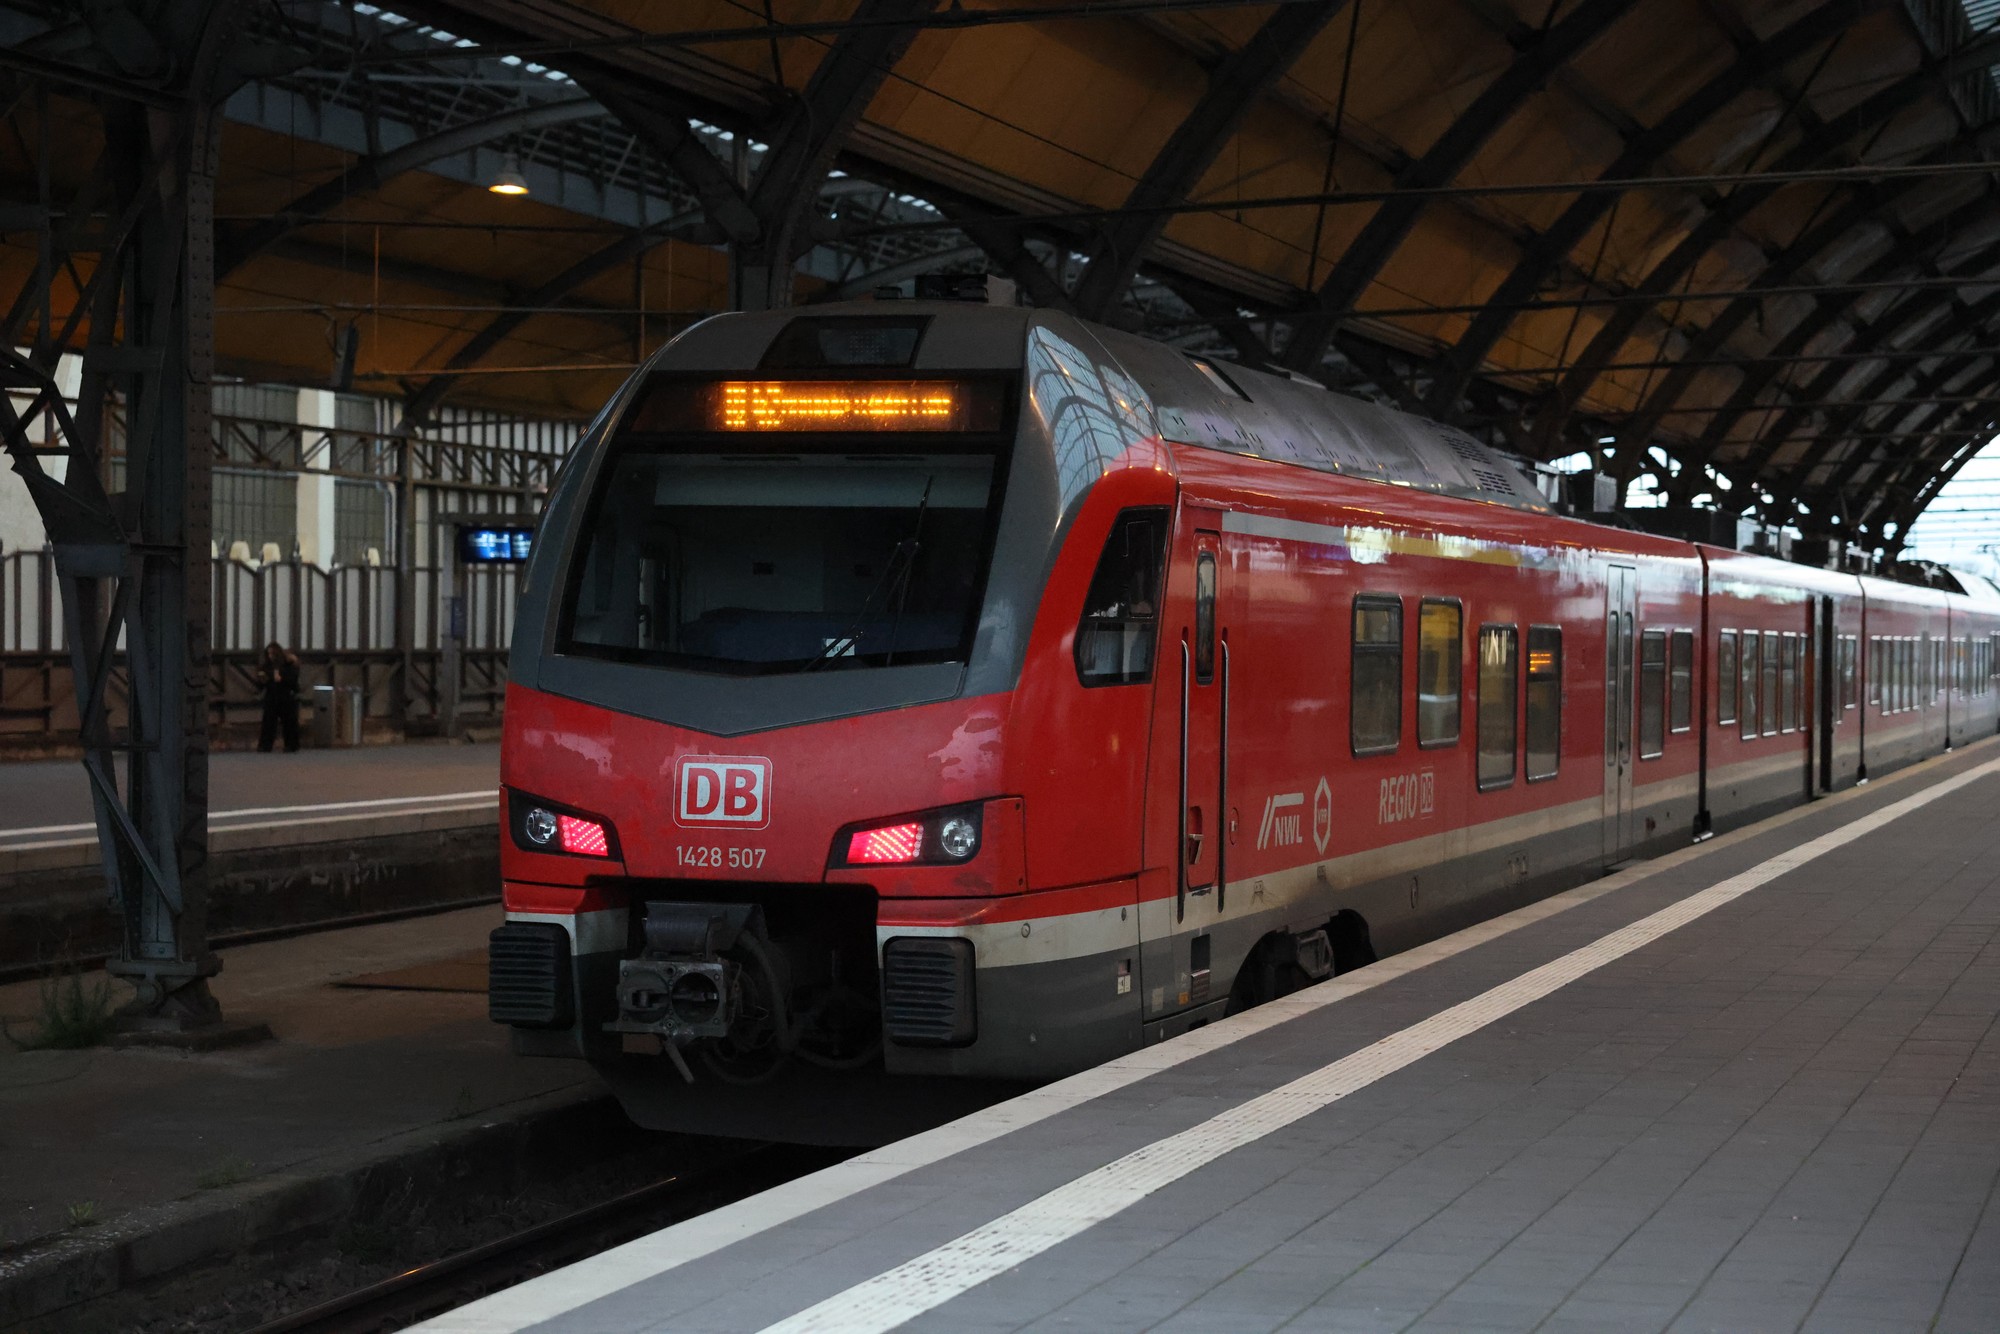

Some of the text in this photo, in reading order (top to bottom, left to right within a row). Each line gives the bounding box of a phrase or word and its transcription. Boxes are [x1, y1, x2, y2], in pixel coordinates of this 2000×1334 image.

[684, 765, 761, 818] DB
[1379, 773, 1418, 824] REGIO
[1274, 814, 1303, 847] NWL
[676, 846, 767, 869] 1428 507
